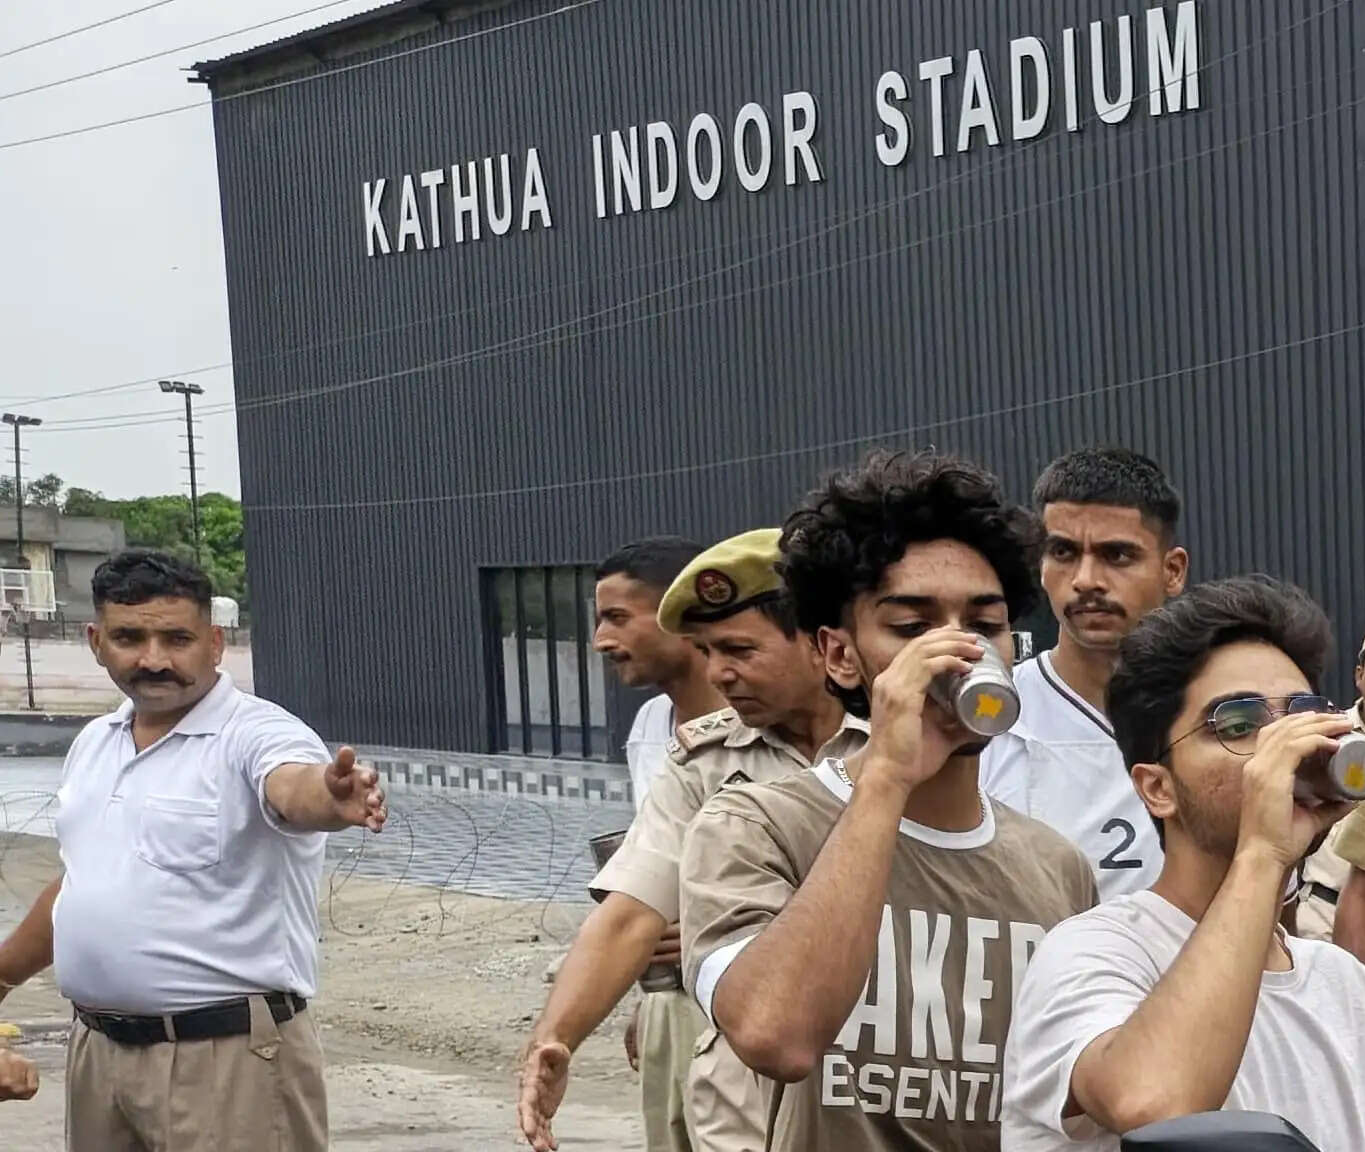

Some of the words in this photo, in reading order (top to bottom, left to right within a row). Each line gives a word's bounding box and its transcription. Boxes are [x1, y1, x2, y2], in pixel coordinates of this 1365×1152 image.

[362, 148, 552, 257] KATHUA
[592, 90, 822, 219] INDOOR
[875, 1, 1201, 167] STADIUM
[1099, 818, 1143, 869] 2
[822, 1054, 1002, 1122] ESENTI
